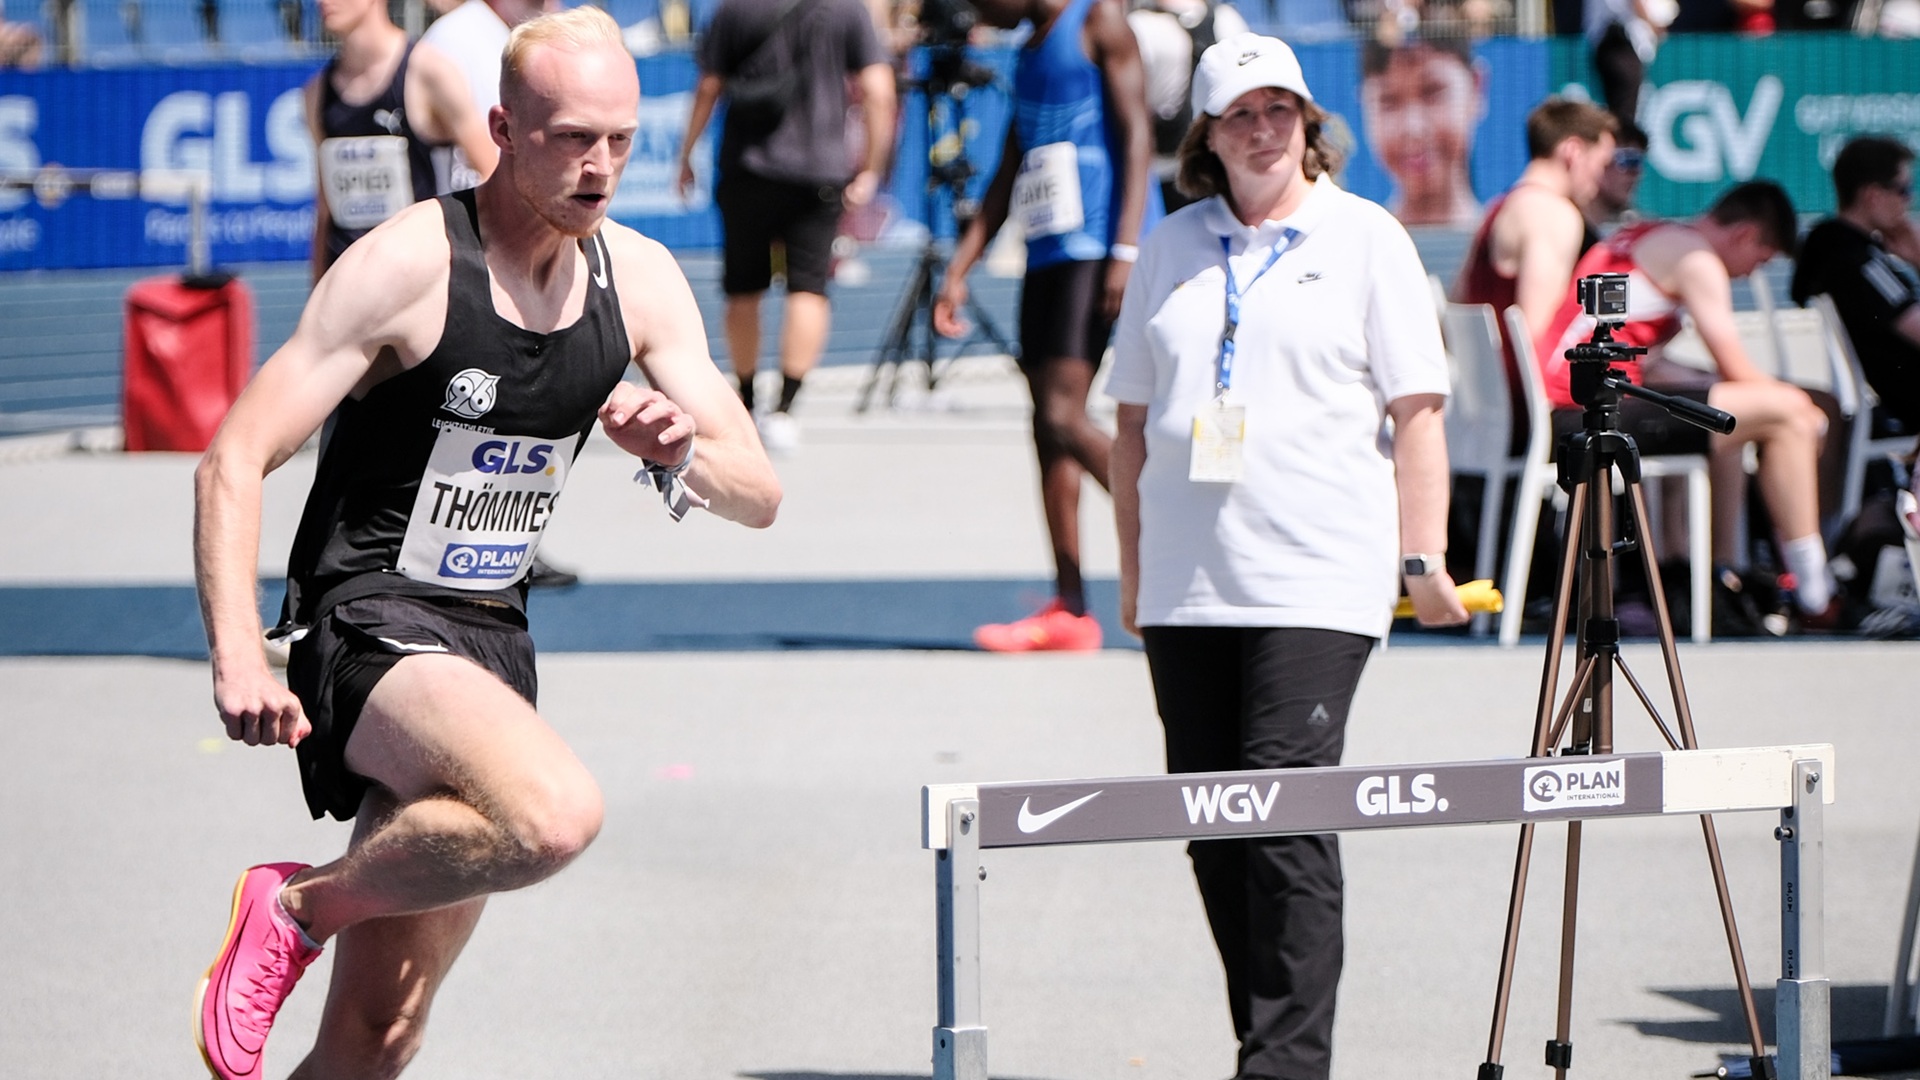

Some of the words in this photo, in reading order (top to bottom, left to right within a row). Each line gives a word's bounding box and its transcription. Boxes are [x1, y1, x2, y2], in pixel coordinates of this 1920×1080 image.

[479, 550, 524, 567] PLAN
[1567, 770, 1620, 790] PLAN
[1181, 781, 1281, 824] WGV
[1567, 792, 1620, 801] INTERNATIONAL
